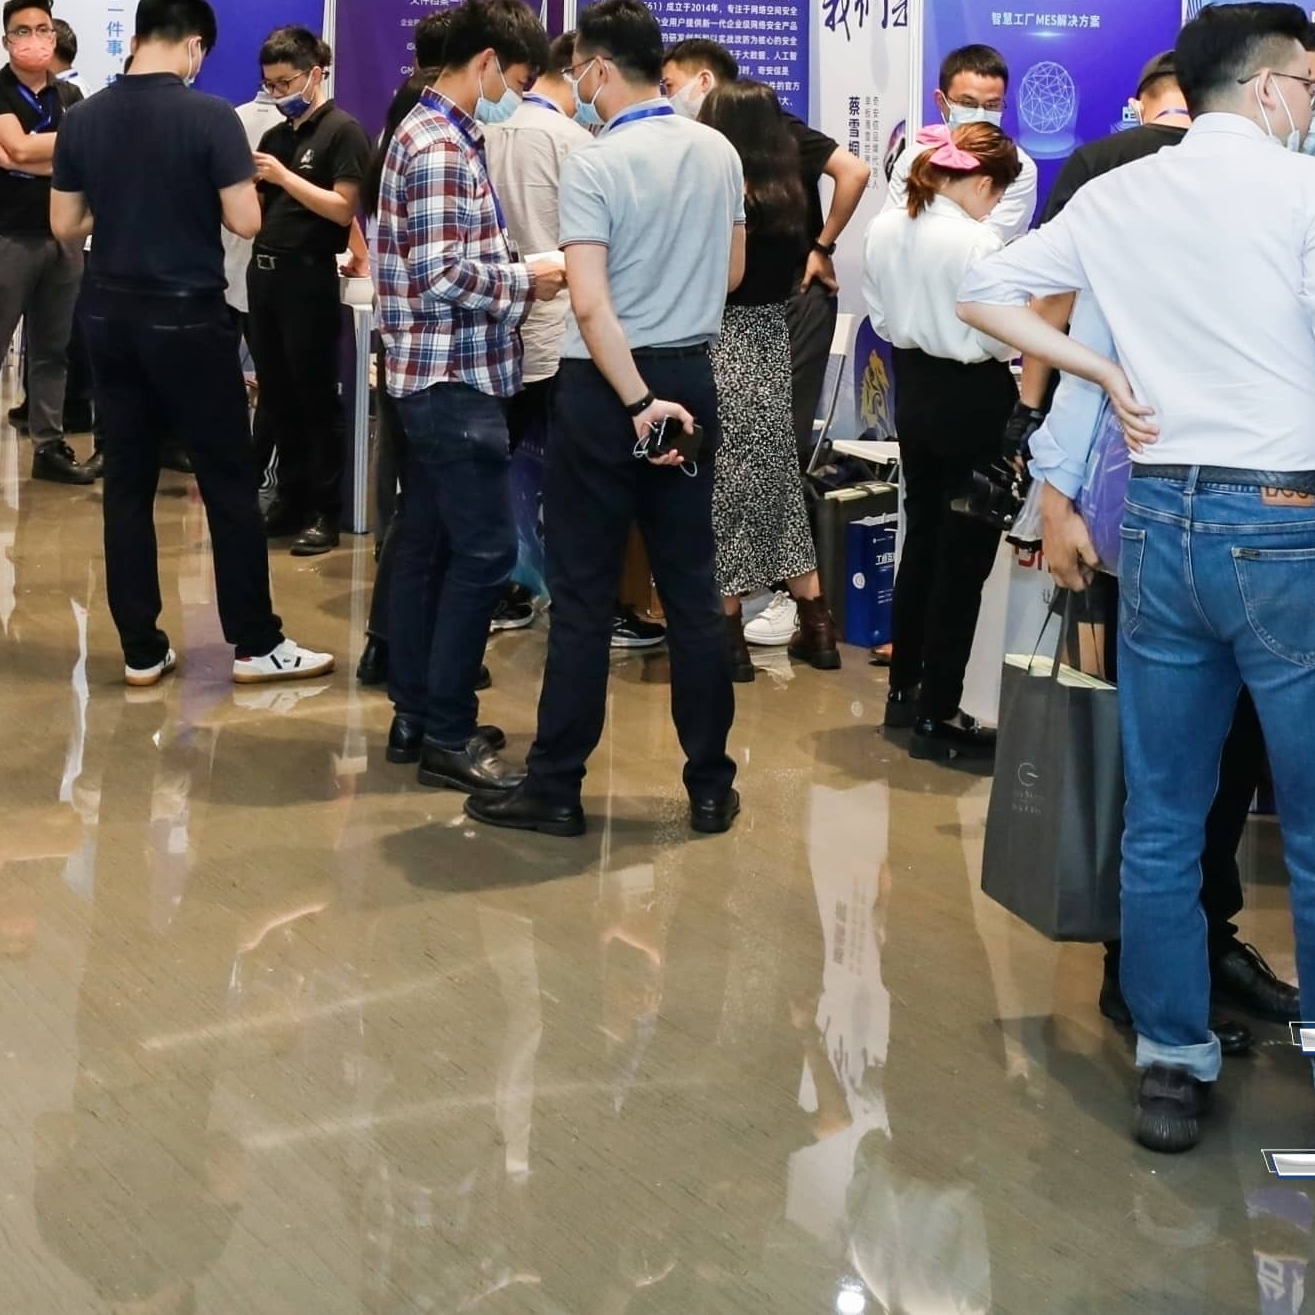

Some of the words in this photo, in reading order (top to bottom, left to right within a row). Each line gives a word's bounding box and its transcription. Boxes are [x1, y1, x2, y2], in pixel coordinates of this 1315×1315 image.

[991, 12, 1101, 29] 智慧工厂MES解决方案
